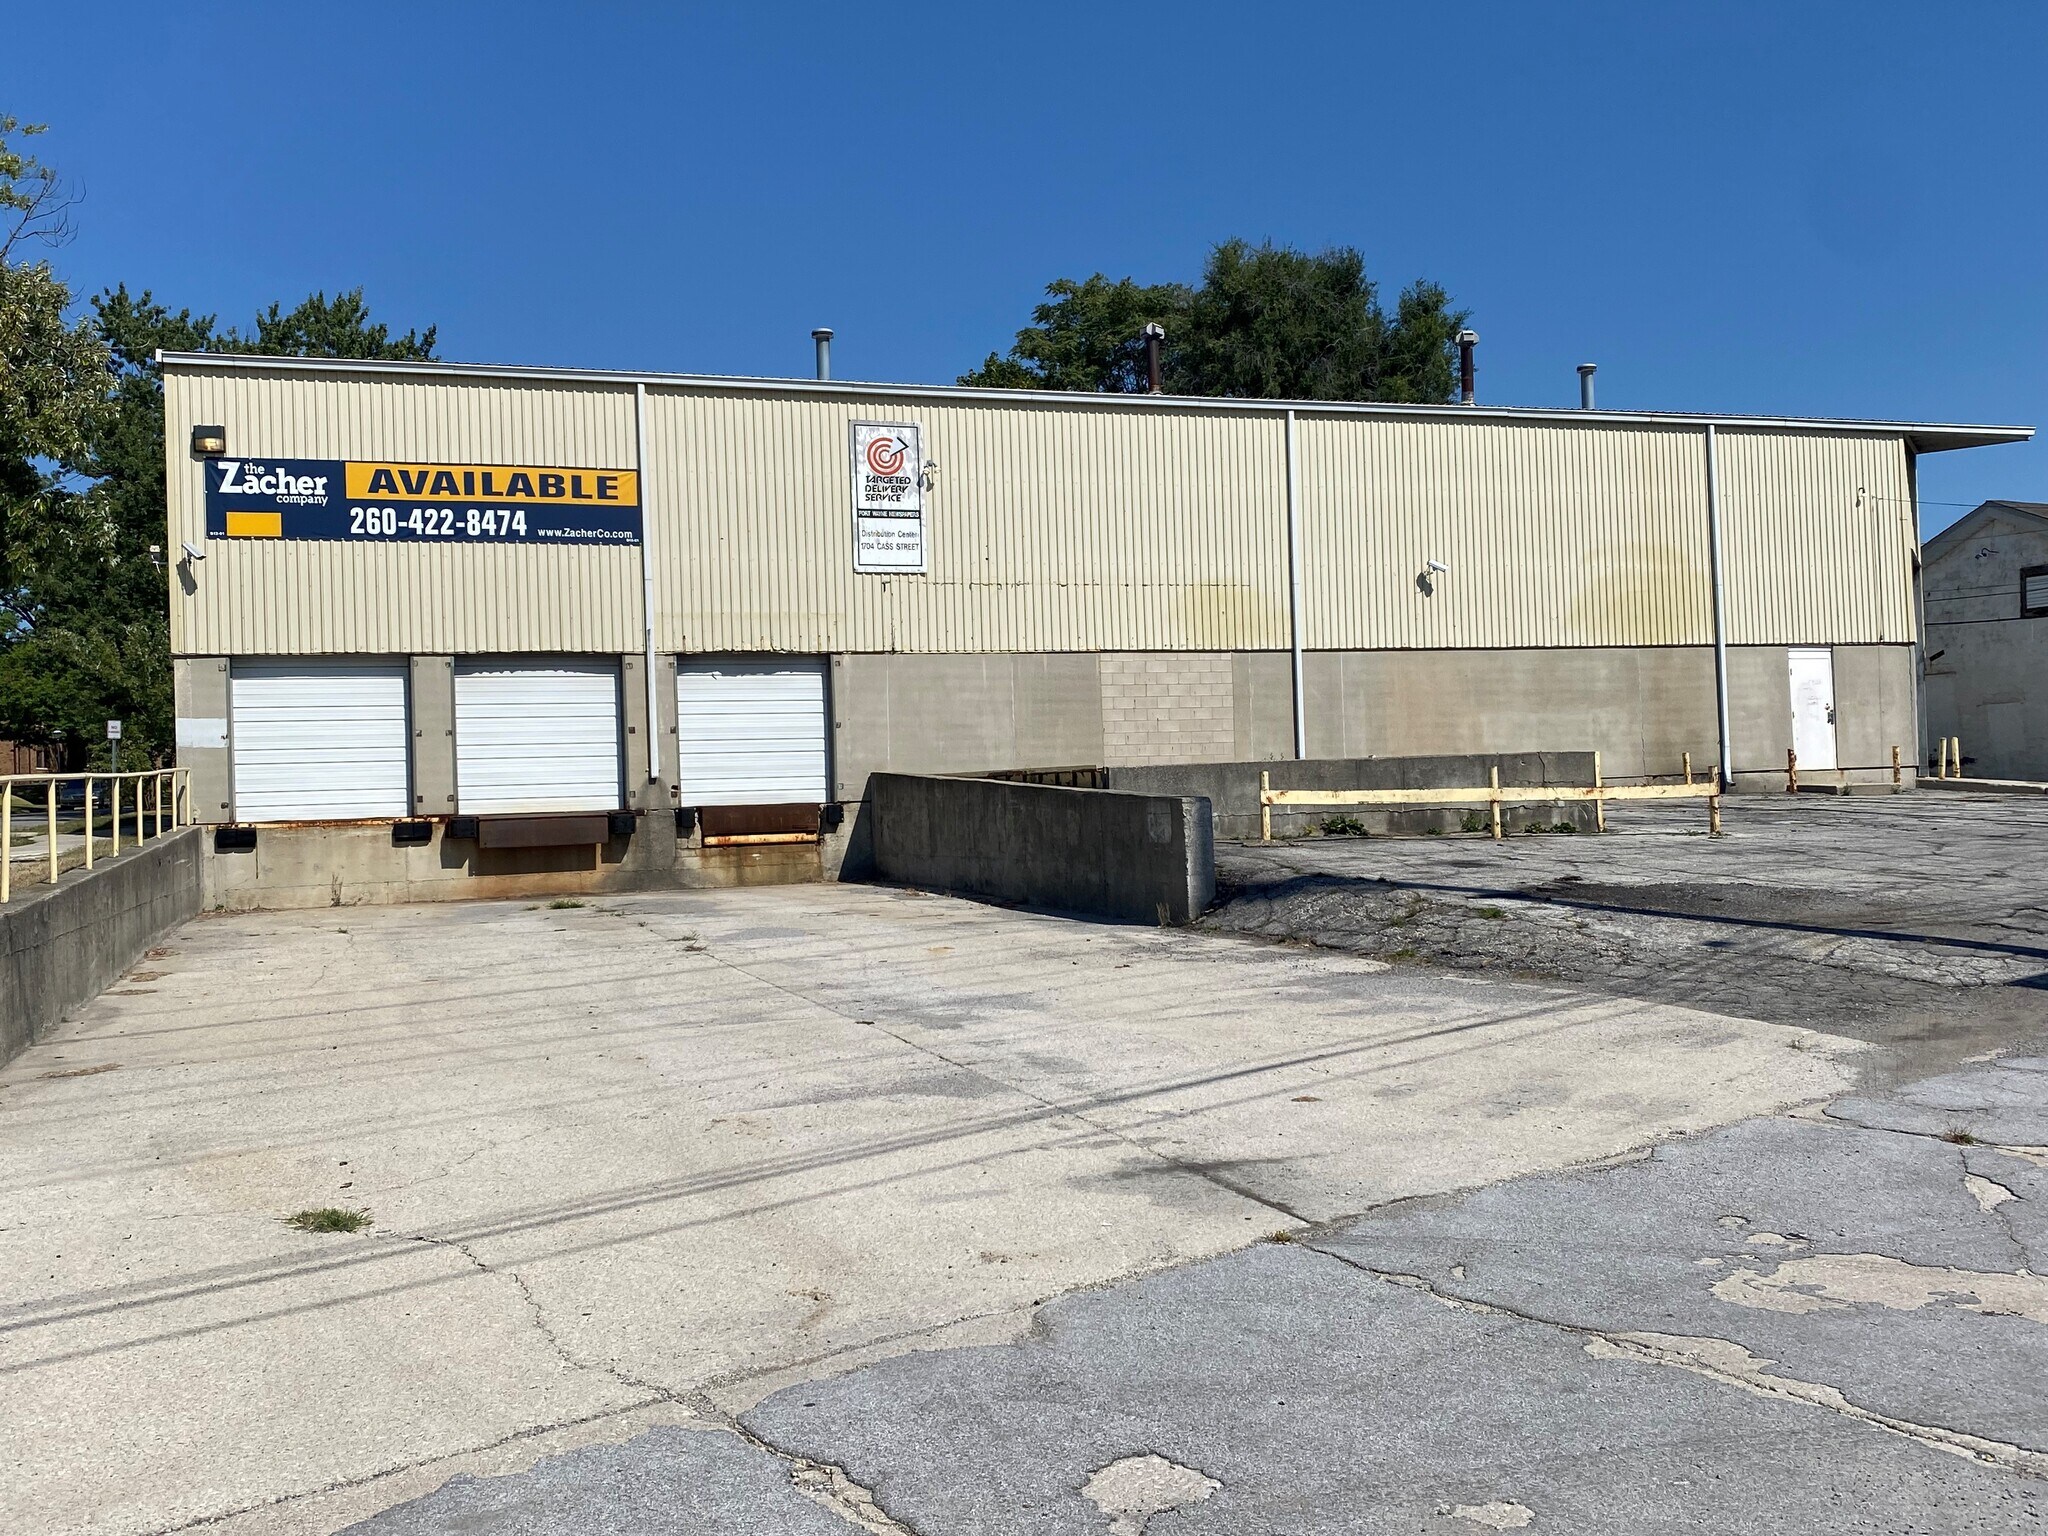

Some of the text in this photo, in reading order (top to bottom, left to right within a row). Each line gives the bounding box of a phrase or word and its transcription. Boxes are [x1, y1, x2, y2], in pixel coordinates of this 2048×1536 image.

[244, 463, 265, 474] the
[218, 461, 328, 495] Zacher
[865, 475, 911, 484] TARGETED
[367, 469, 618, 500] AVAILABLE
[865, 485, 908, 493] DELIVERY
[276, 495, 328, 507] company
[865, 494, 901, 502] SERVICE
[350, 507, 527, 536] 260-422-8474
[537, 528, 633, 539] www.ZacherCo.com
[861, 529, 895, 538] Distribution
[861, 542, 920, 551] 1704 CASS STREET
